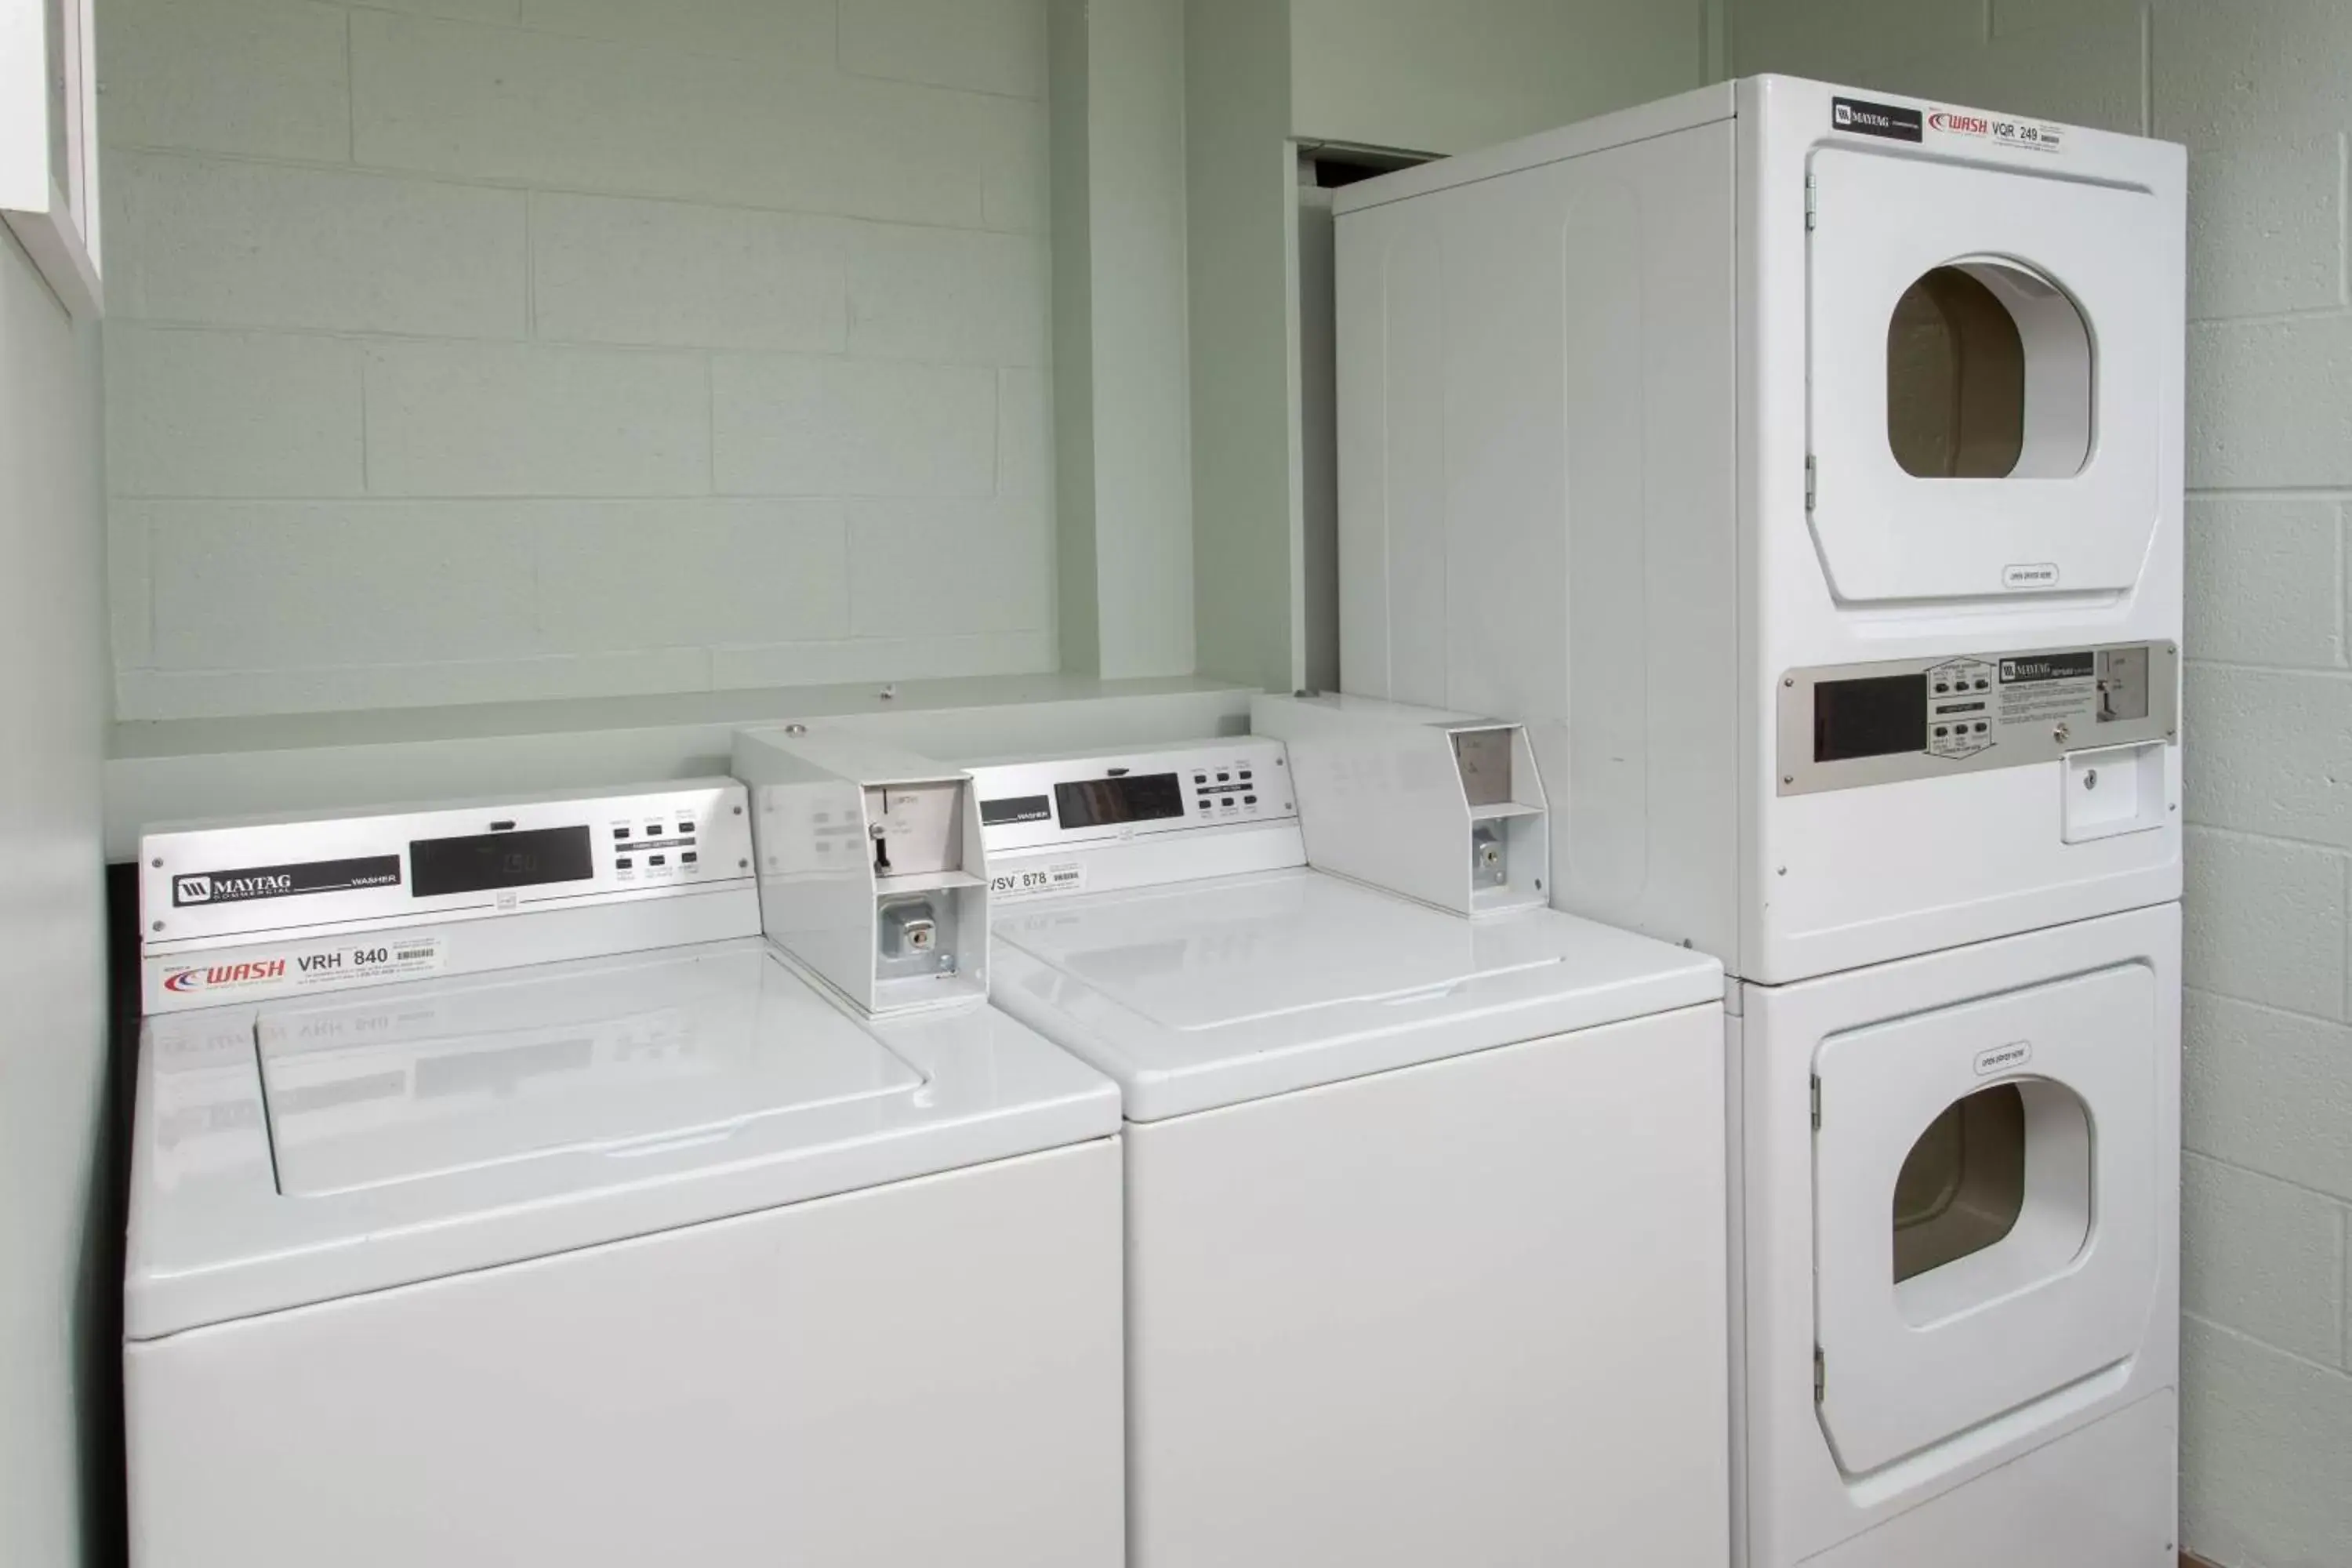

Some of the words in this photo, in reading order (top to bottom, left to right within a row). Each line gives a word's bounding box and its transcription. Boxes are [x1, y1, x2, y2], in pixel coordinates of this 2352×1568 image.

[1948, 116, 1987, 132] WASH
[1992, 122, 2015, 136] VQR
[2020, 126, 2038, 141] 249
[213, 874, 291, 895] MAYTAG
[351, 874, 397, 886] WASHER
[1022, 871, 1047, 886] 878
[213, 888, 290, 900] COMMERCIAL
[298, 953, 341, 971] VRH
[354, 947, 388, 965] 840
[207, 959, 285, 983] WASH
